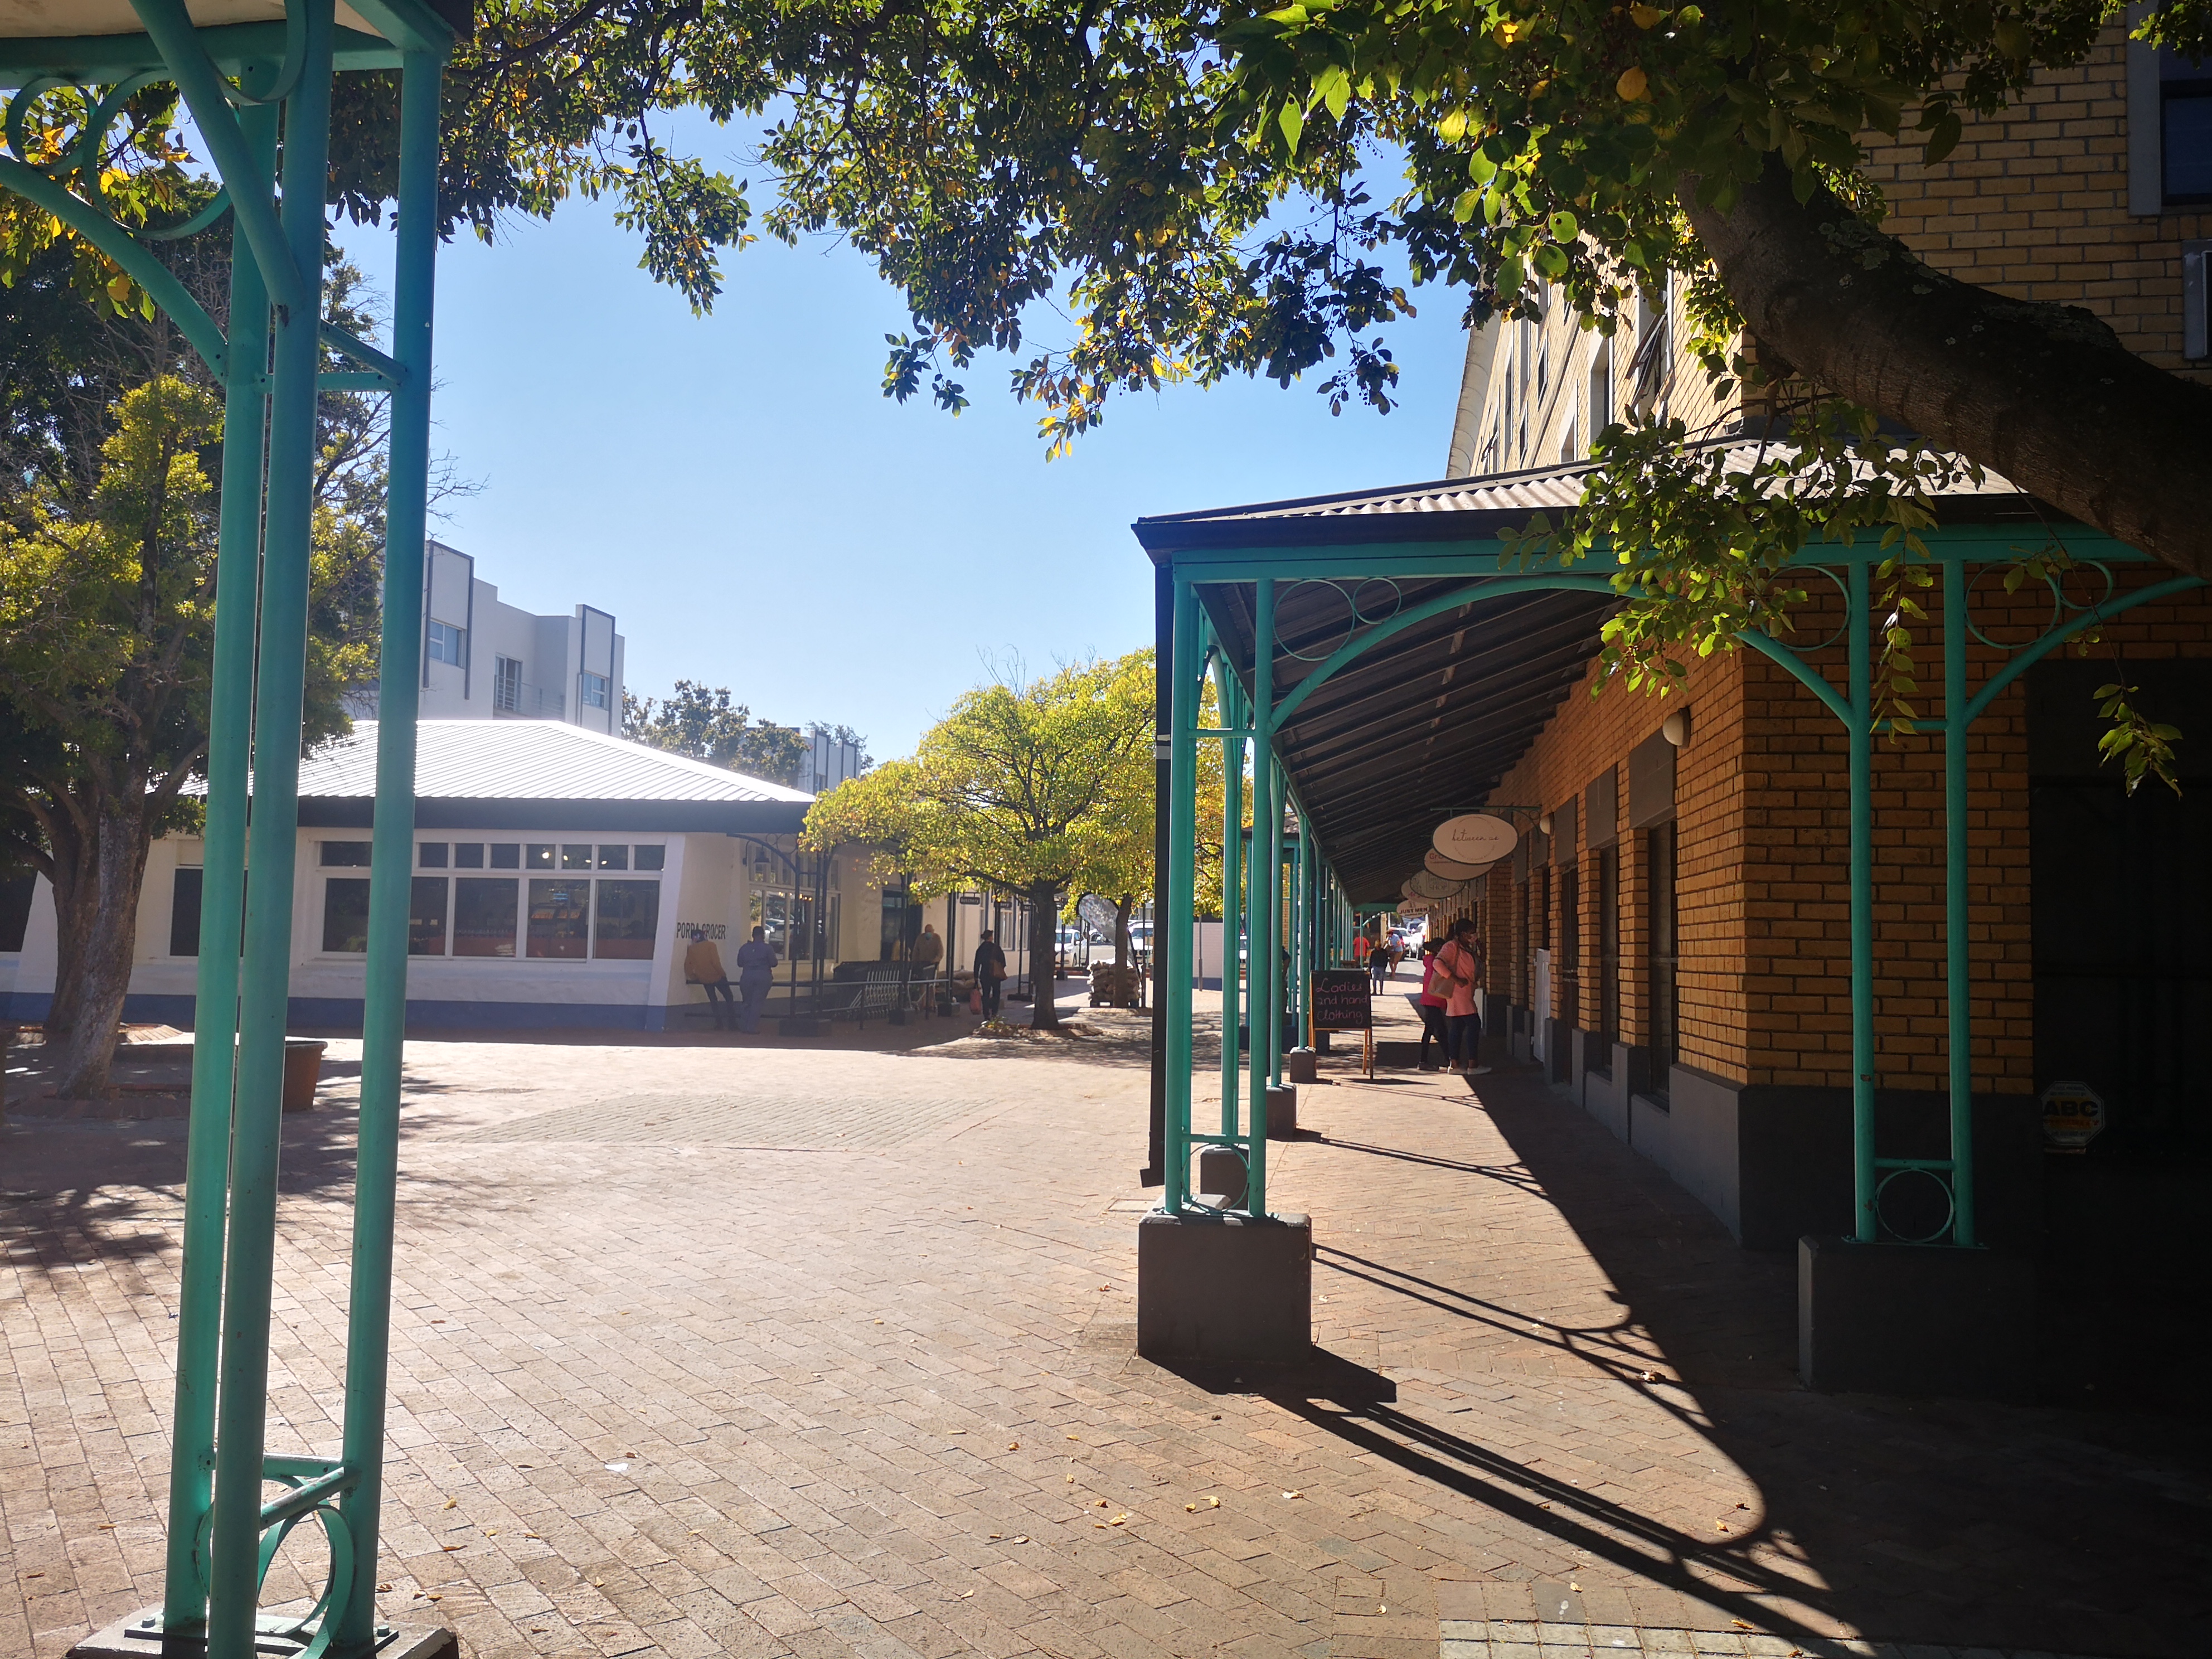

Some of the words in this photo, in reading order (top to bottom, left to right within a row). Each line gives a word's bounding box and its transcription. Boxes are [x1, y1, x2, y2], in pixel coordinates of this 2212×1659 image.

[1452, 829, 1486, 841] between
[1316, 978, 1362, 993] Ladies
[1341, 994, 1367, 1005] hand
[2044, 1101, 2098, 1117] ABC
